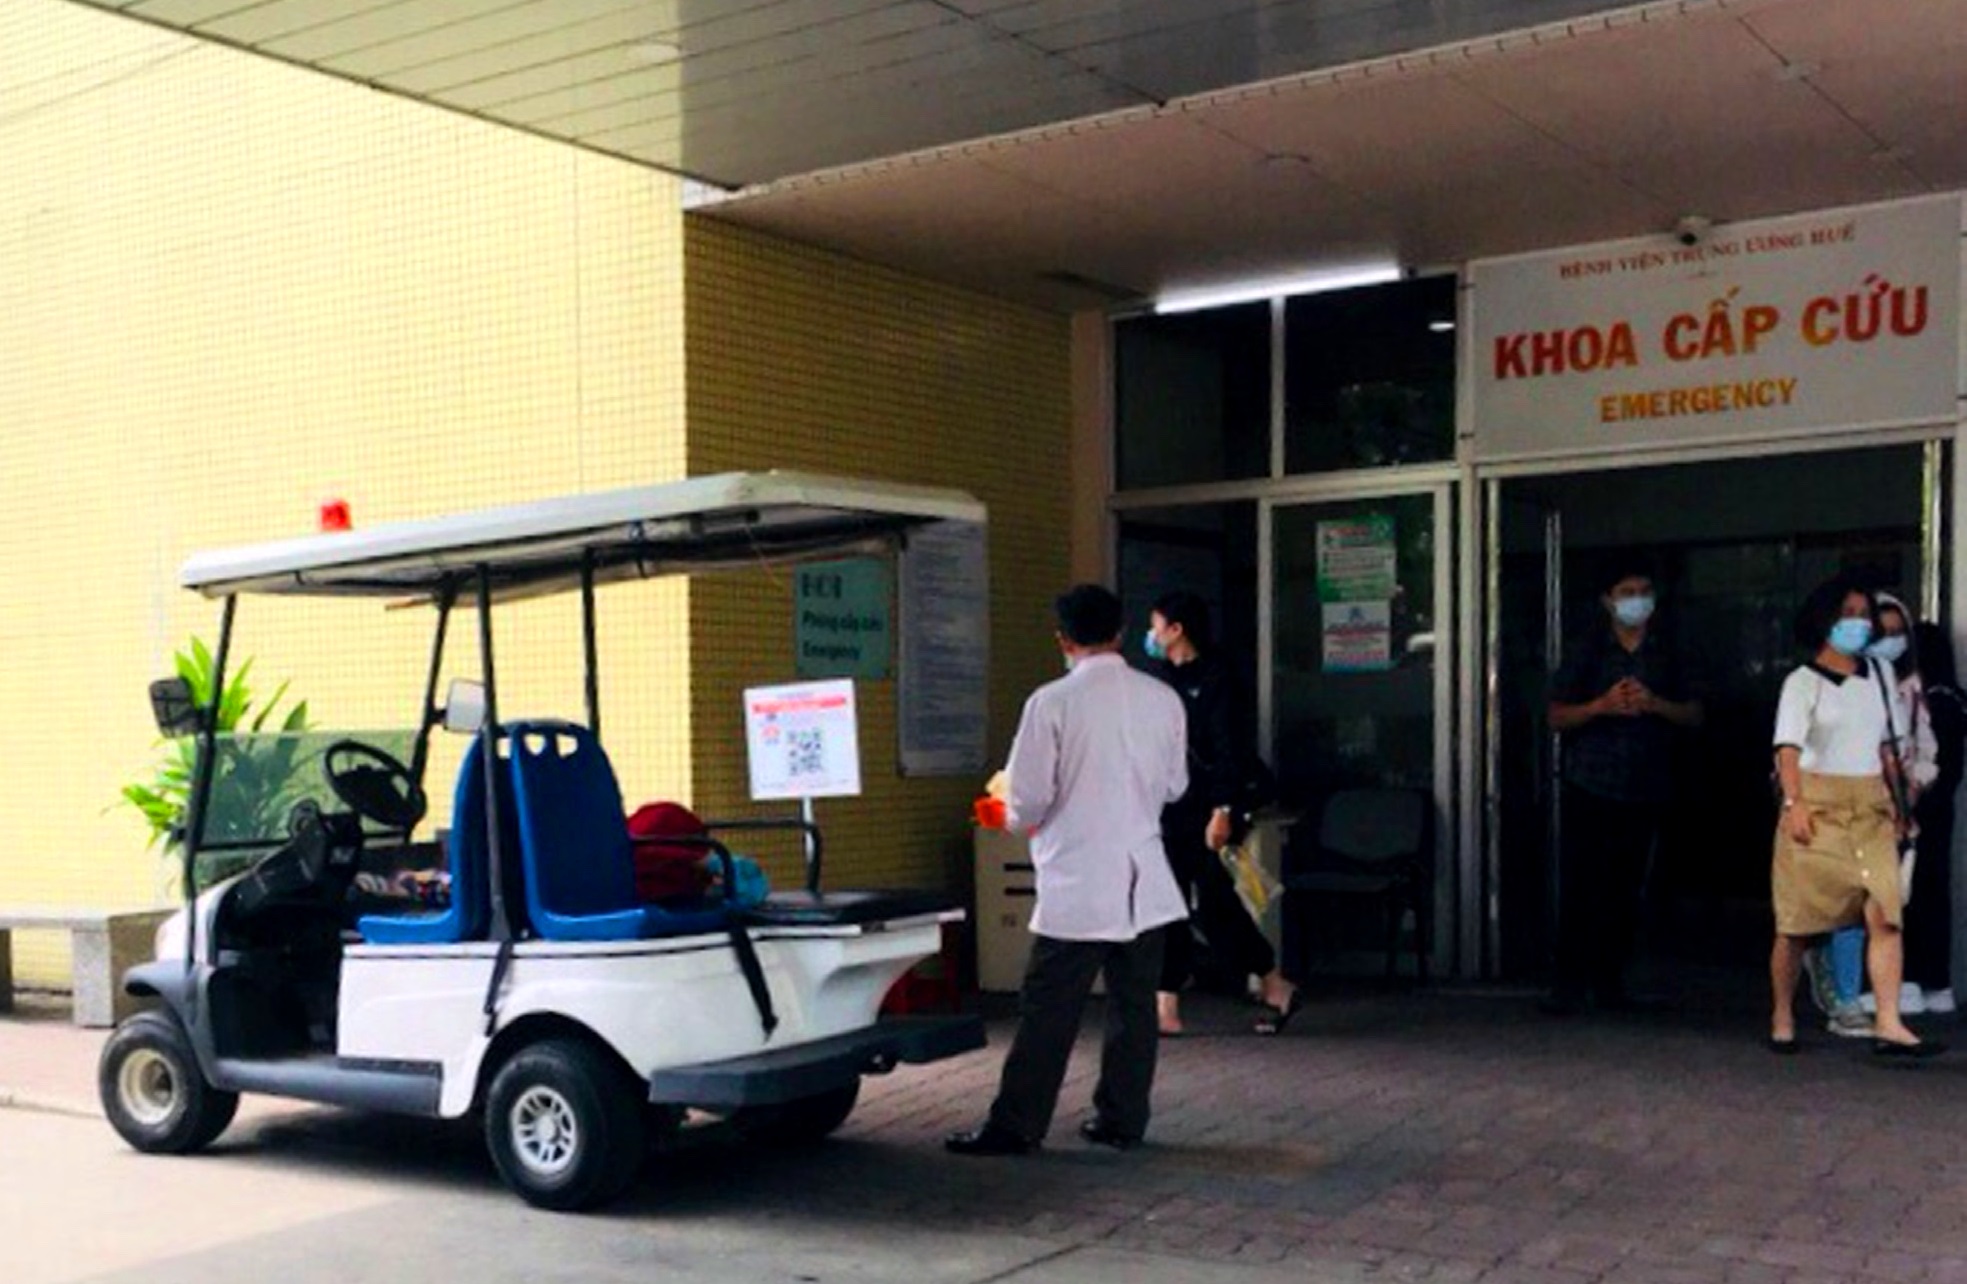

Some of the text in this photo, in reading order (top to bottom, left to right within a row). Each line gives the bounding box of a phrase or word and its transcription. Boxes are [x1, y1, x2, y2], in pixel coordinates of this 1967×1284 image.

[1494, 273, 1930, 380] KHOA CẤP CỨU
[1599, 377, 1797, 423] EMERGENCY
